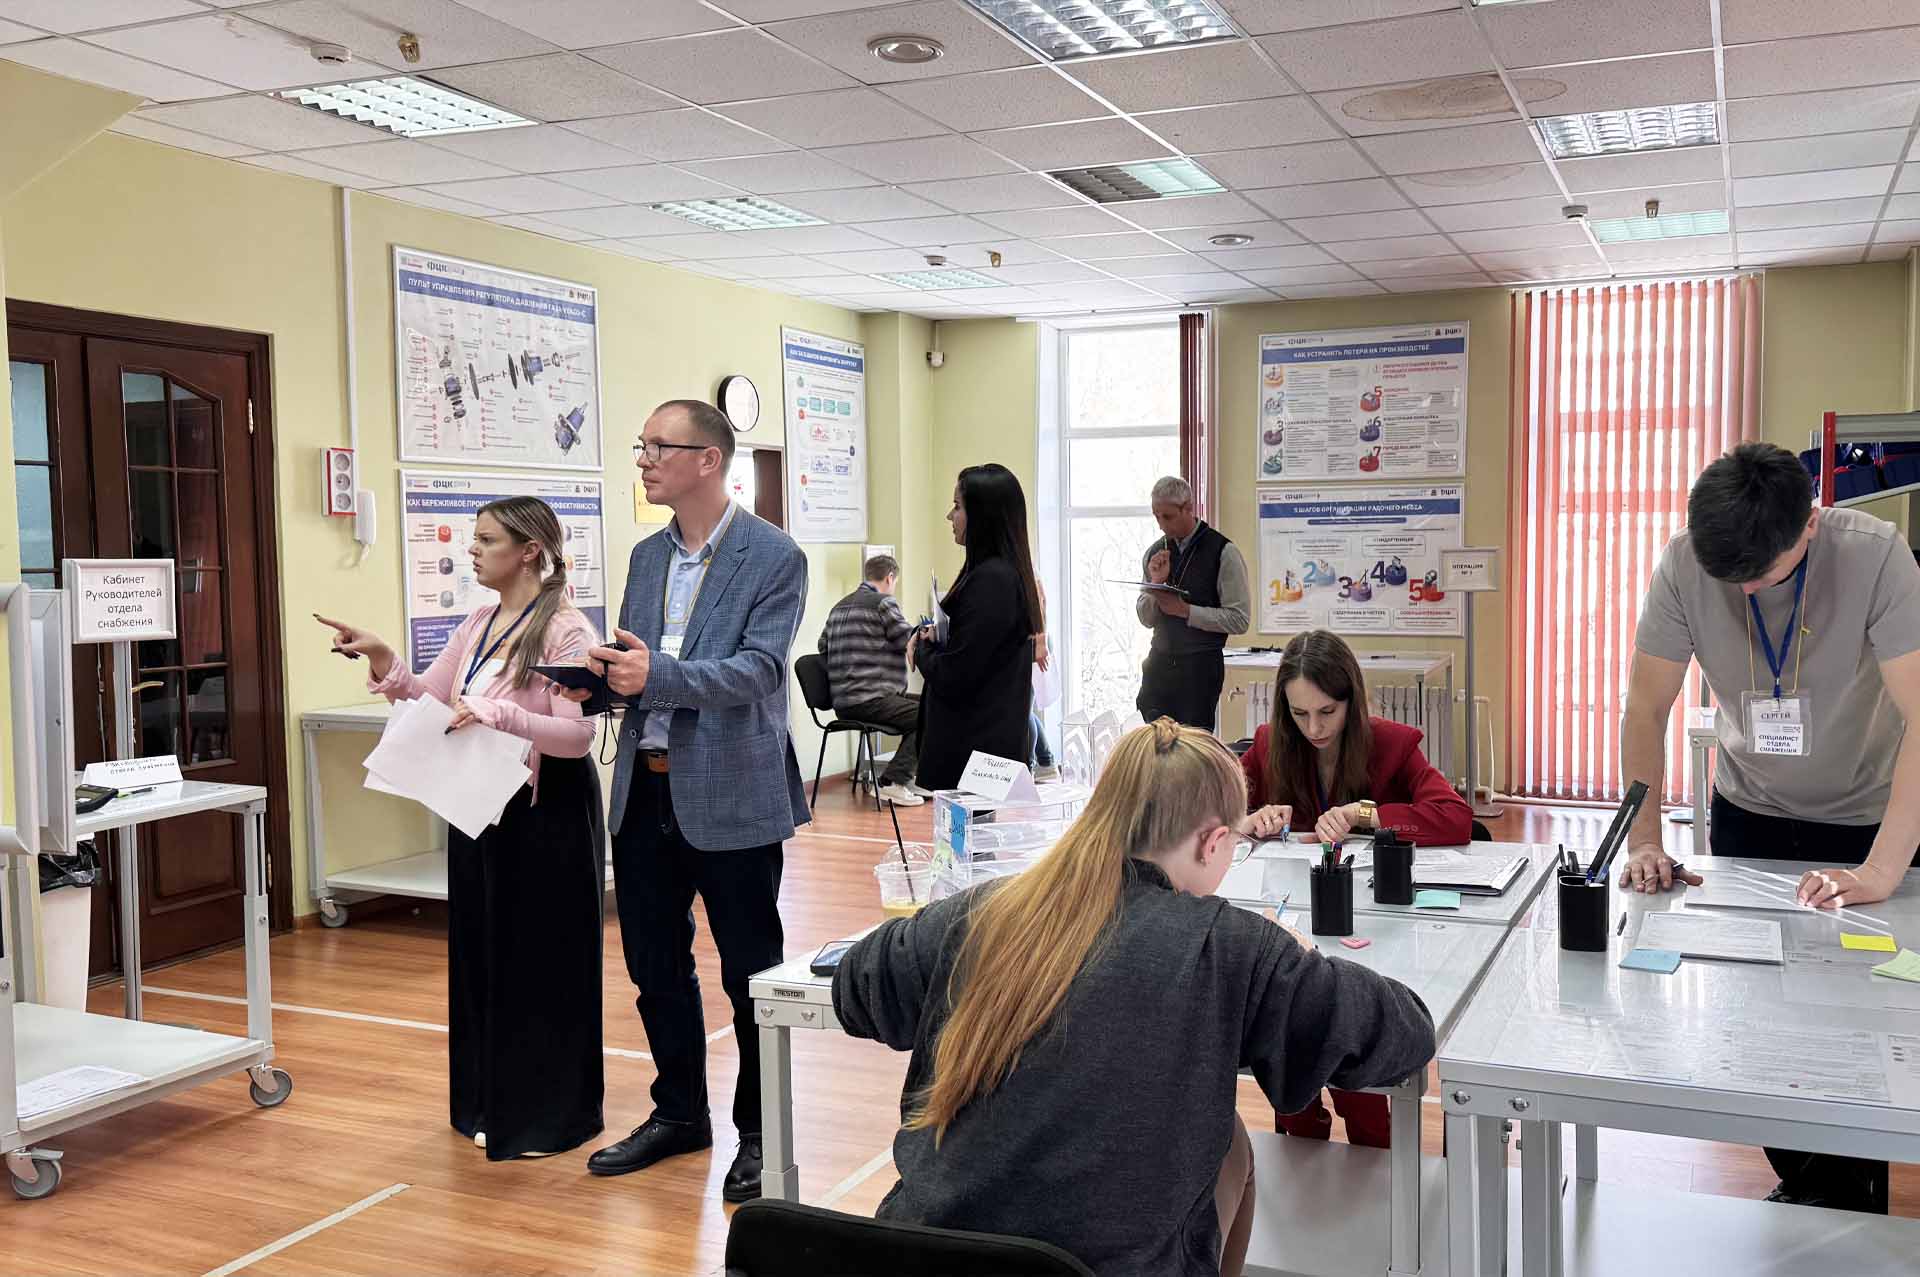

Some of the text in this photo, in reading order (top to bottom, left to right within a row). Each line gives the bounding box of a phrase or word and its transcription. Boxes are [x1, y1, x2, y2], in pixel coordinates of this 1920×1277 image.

[408, 278, 431, 290] ПУЛЬТ
[431, 282, 475, 297] УПРАВЛЕНИЯ
[475, 290, 514, 305] РЕГУЛЯТОРА
[1307, 350, 1343, 358] УСТРАНИТЬ
[1344, 348, 1368, 356] ПОТЕРИ
[433, 480, 453, 489] ФЦК
[407, 499, 420, 507] КАК
[421, 499, 466, 508] БЕРЕЖЛИВОЕ
[1303, 561, 1317, 583] 2
[1370, 560, 1385, 583] 4
[103, 575, 145, 585] Кабинет
[1269, 579, 1281, 603] 1
[1338, 576, 1352, 599] 3
[1409, 579, 1424, 602] 5
[85, 588, 162, 601] Руководителей
[107, 605, 143, 614] отдела
[97, 618, 153, 629] снабжения
